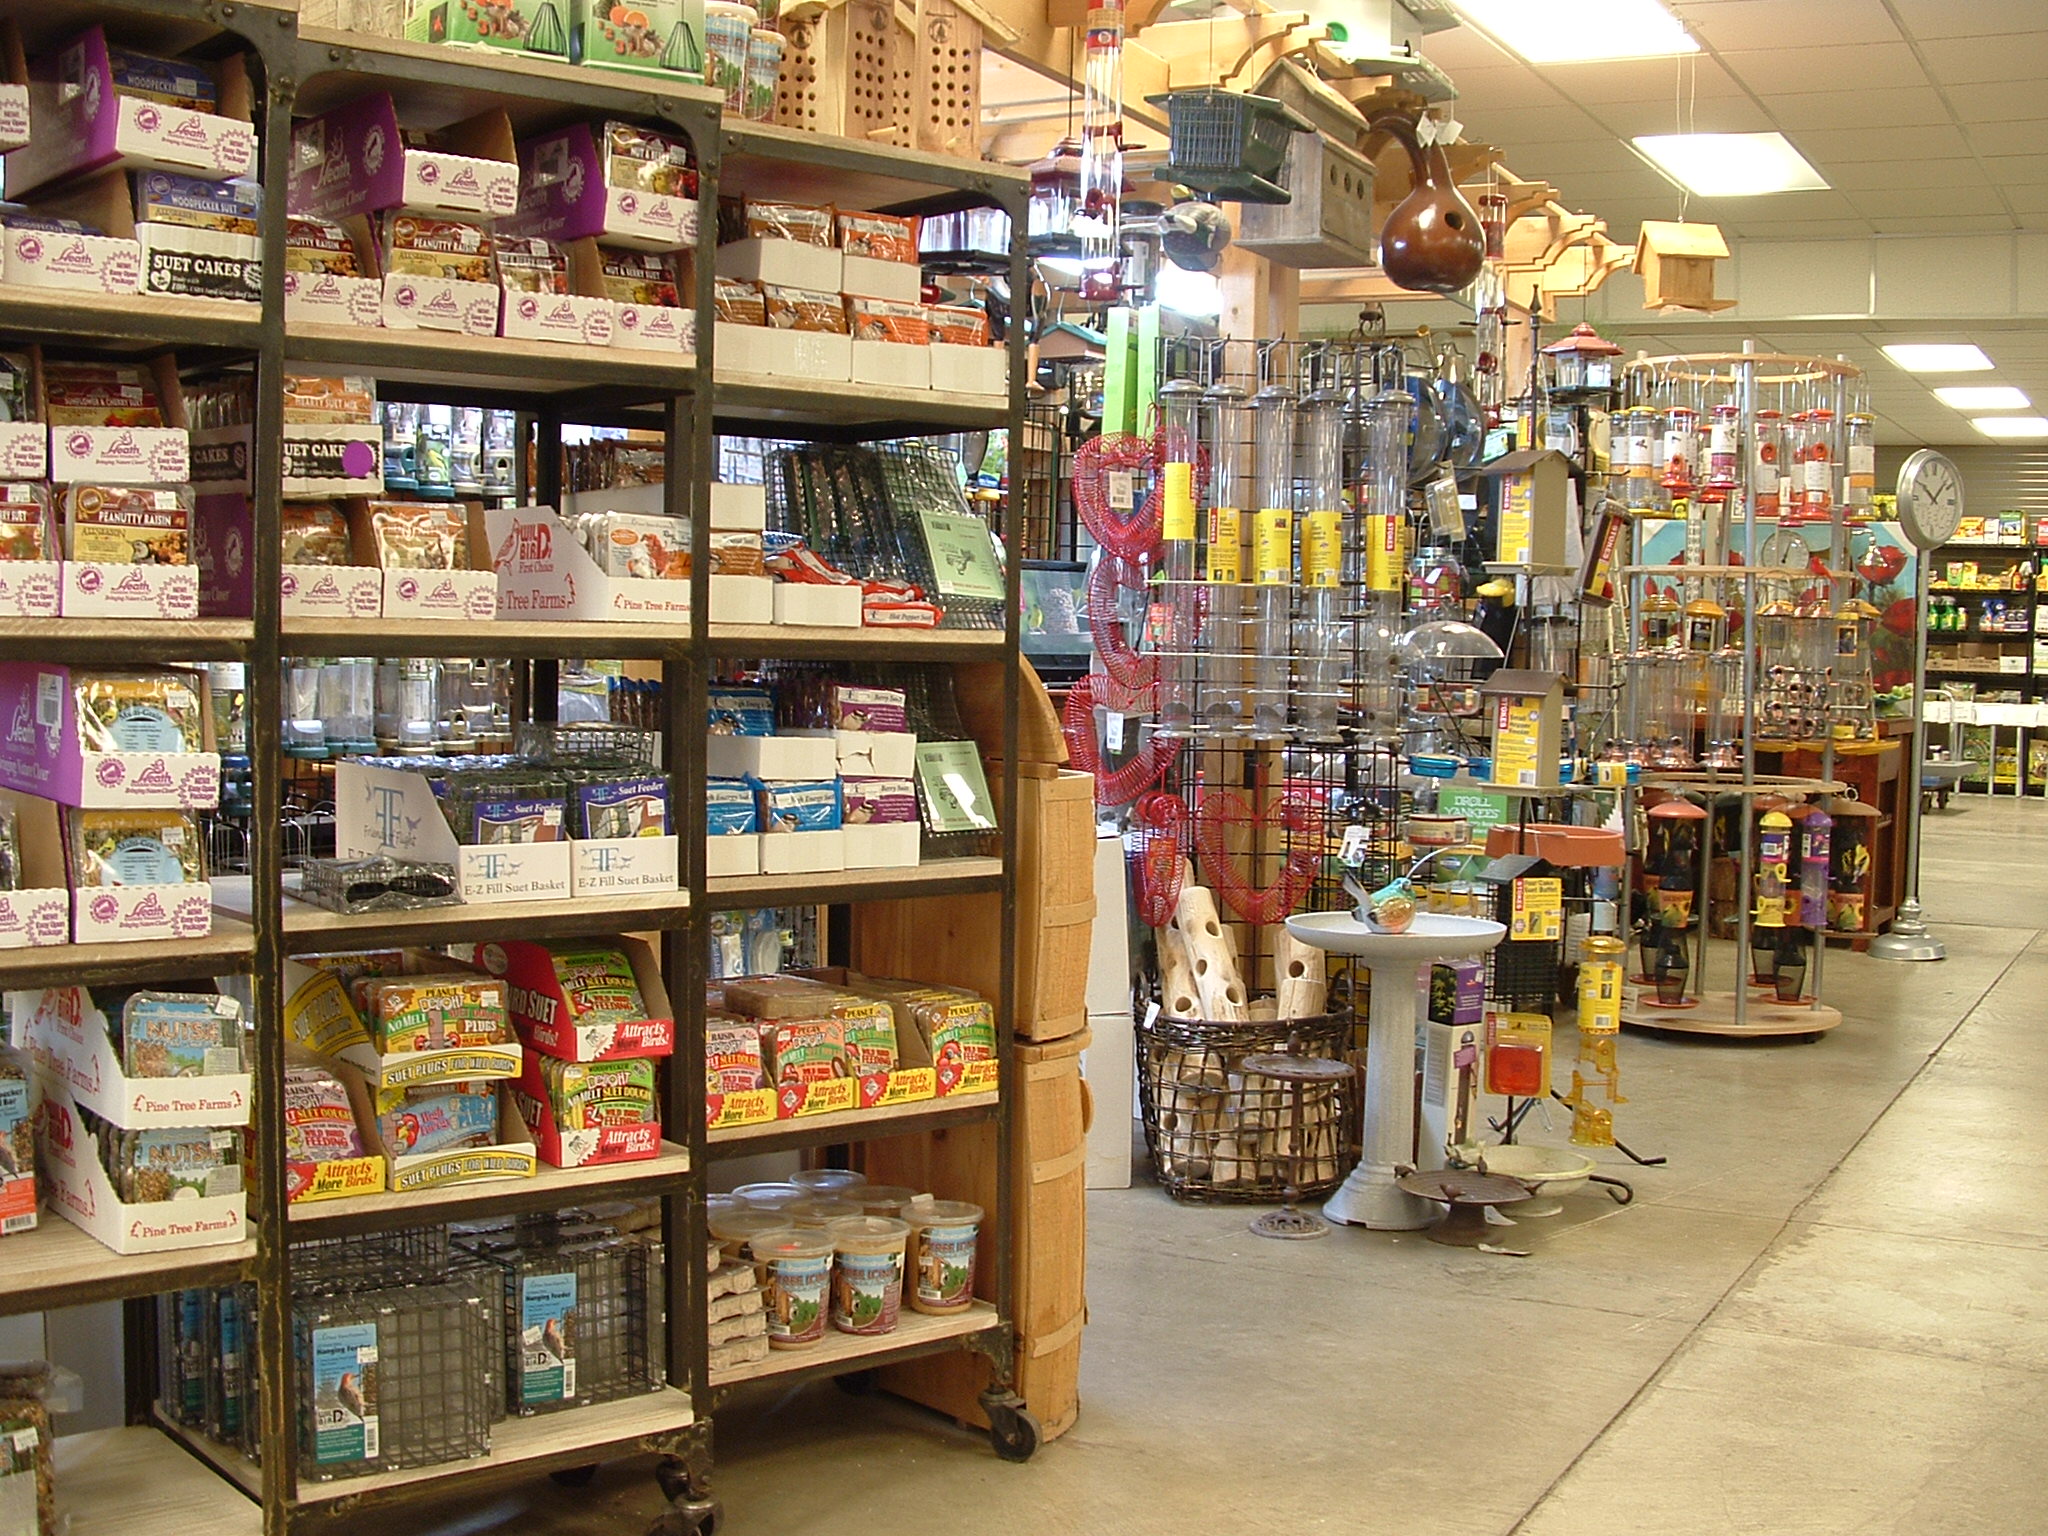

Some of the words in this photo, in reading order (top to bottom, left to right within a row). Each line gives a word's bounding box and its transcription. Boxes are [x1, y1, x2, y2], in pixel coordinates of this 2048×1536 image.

[154, 254, 191, 272] SUET
[194, 259, 241, 278] CAKES
[194, 450, 228, 463] CAKES
[284, 443, 310, 457] UET
[311, 443, 346, 457] CAKE
[99, 511, 143, 525] PEANUTTY
[144, 513, 171, 527] RAISIN
[112, 575, 151, 591] Heath
[506, 590, 530, 610] Tree
[532, 590, 566, 610] Farms
[624, 600, 642, 610] Pine
[645, 600, 663, 610] Tree
[132, 768, 173, 785] Heath
[618, 785, 636, 796] Suet
[637, 782, 664, 794] Feeder
[1455, 796, 1492, 807] DROLL
[515, 804, 534, 814] Suet
[1444, 806, 1501, 819] YANKEES
[464, 884, 483, 895] E-Z
[486, 882, 503, 894] Fill
[505, 881, 528, 893] Suet
[531, 879, 565, 891] Basket
[579, 878, 596, 888] E-Z
[599, 876, 615, 887] Fill
[617, 874, 639, 885] Suet
[641, 873, 674, 885] Basket
[125, 900, 166, 917] Heath
[426, 987, 457, 997] PEANUT
[528, 989, 558, 1026] SUET
[847, 1008, 873, 1017] PEANUT
[950, 1006, 975, 1015] PEANUT
[387, 1019, 403, 1033] NO
[404, 1013, 426, 1028] MELT
[465, 1020, 497, 1032] PLUGS
[621, 1023, 665, 1038] Attracts
[711, 1033, 735, 1041] RAISIN
[642, 1034, 669, 1047] Birds!
[388, 1068, 413, 1084] SUET
[415, 1059, 448, 1076] PLUGS
[469, 1057, 487, 1070] WILD
[490, 1058, 515, 1072] BIRDS
[896, 1073, 927, 1086] Attracts
[963, 1075, 981, 1084] More
[286, 1086, 315, 1096] AISIN
[602, 1087, 623, 1097] SUET
[624, 1087, 651, 1100] DOUGH
[815, 1083, 846, 1096] Attracts
[889, 1086, 907, 1095] More
[909, 1082, 932, 1094] Birds!
[146, 1101, 169, 1112] Pine
[172, 1101, 196, 1111] Tree
[198, 1099, 232, 1110] Farms
[730, 1095, 764, 1108] Attracts
[808, 1099, 826, 1108] More
[827, 1093, 850, 1105] Birds!
[297, 1109, 319, 1119] SUET
[320, 1108, 351, 1119] DOUGH
[421, 1107, 444, 1122] High
[518, 1092, 543, 1127] SUET
[724, 1110, 742, 1119] More
[744, 1107, 769, 1118] Birds!
[421, 1118, 450, 1136] Energy
[306, 1137, 349, 1147] FEEDING
[605, 1129, 651, 1144] Attracts
[626, 1139, 655, 1153] Birds!
[325, 1162, 372, 1178] Attracts
[402, 1171, 426, 1187] SUET
[429, 1162, 461, 1178] PLUGS
[464, 1160, 481, 1171] FOR
[482, 1158, 502, 1170] WILD
[504, 1159, 530, 1172] BIRDS
[317, 1179, 343, 1190] More
[345, 1173, 378, 1187] Birds!
[143, 1227, 166, 1238] Pine
[169, 1224, 193, 1235] Tree
[195, 1221, 228, 1233] Farms
[526, 1293, 549, 1301] Hanging
[317, 1346, 345, 1355] Hanging
